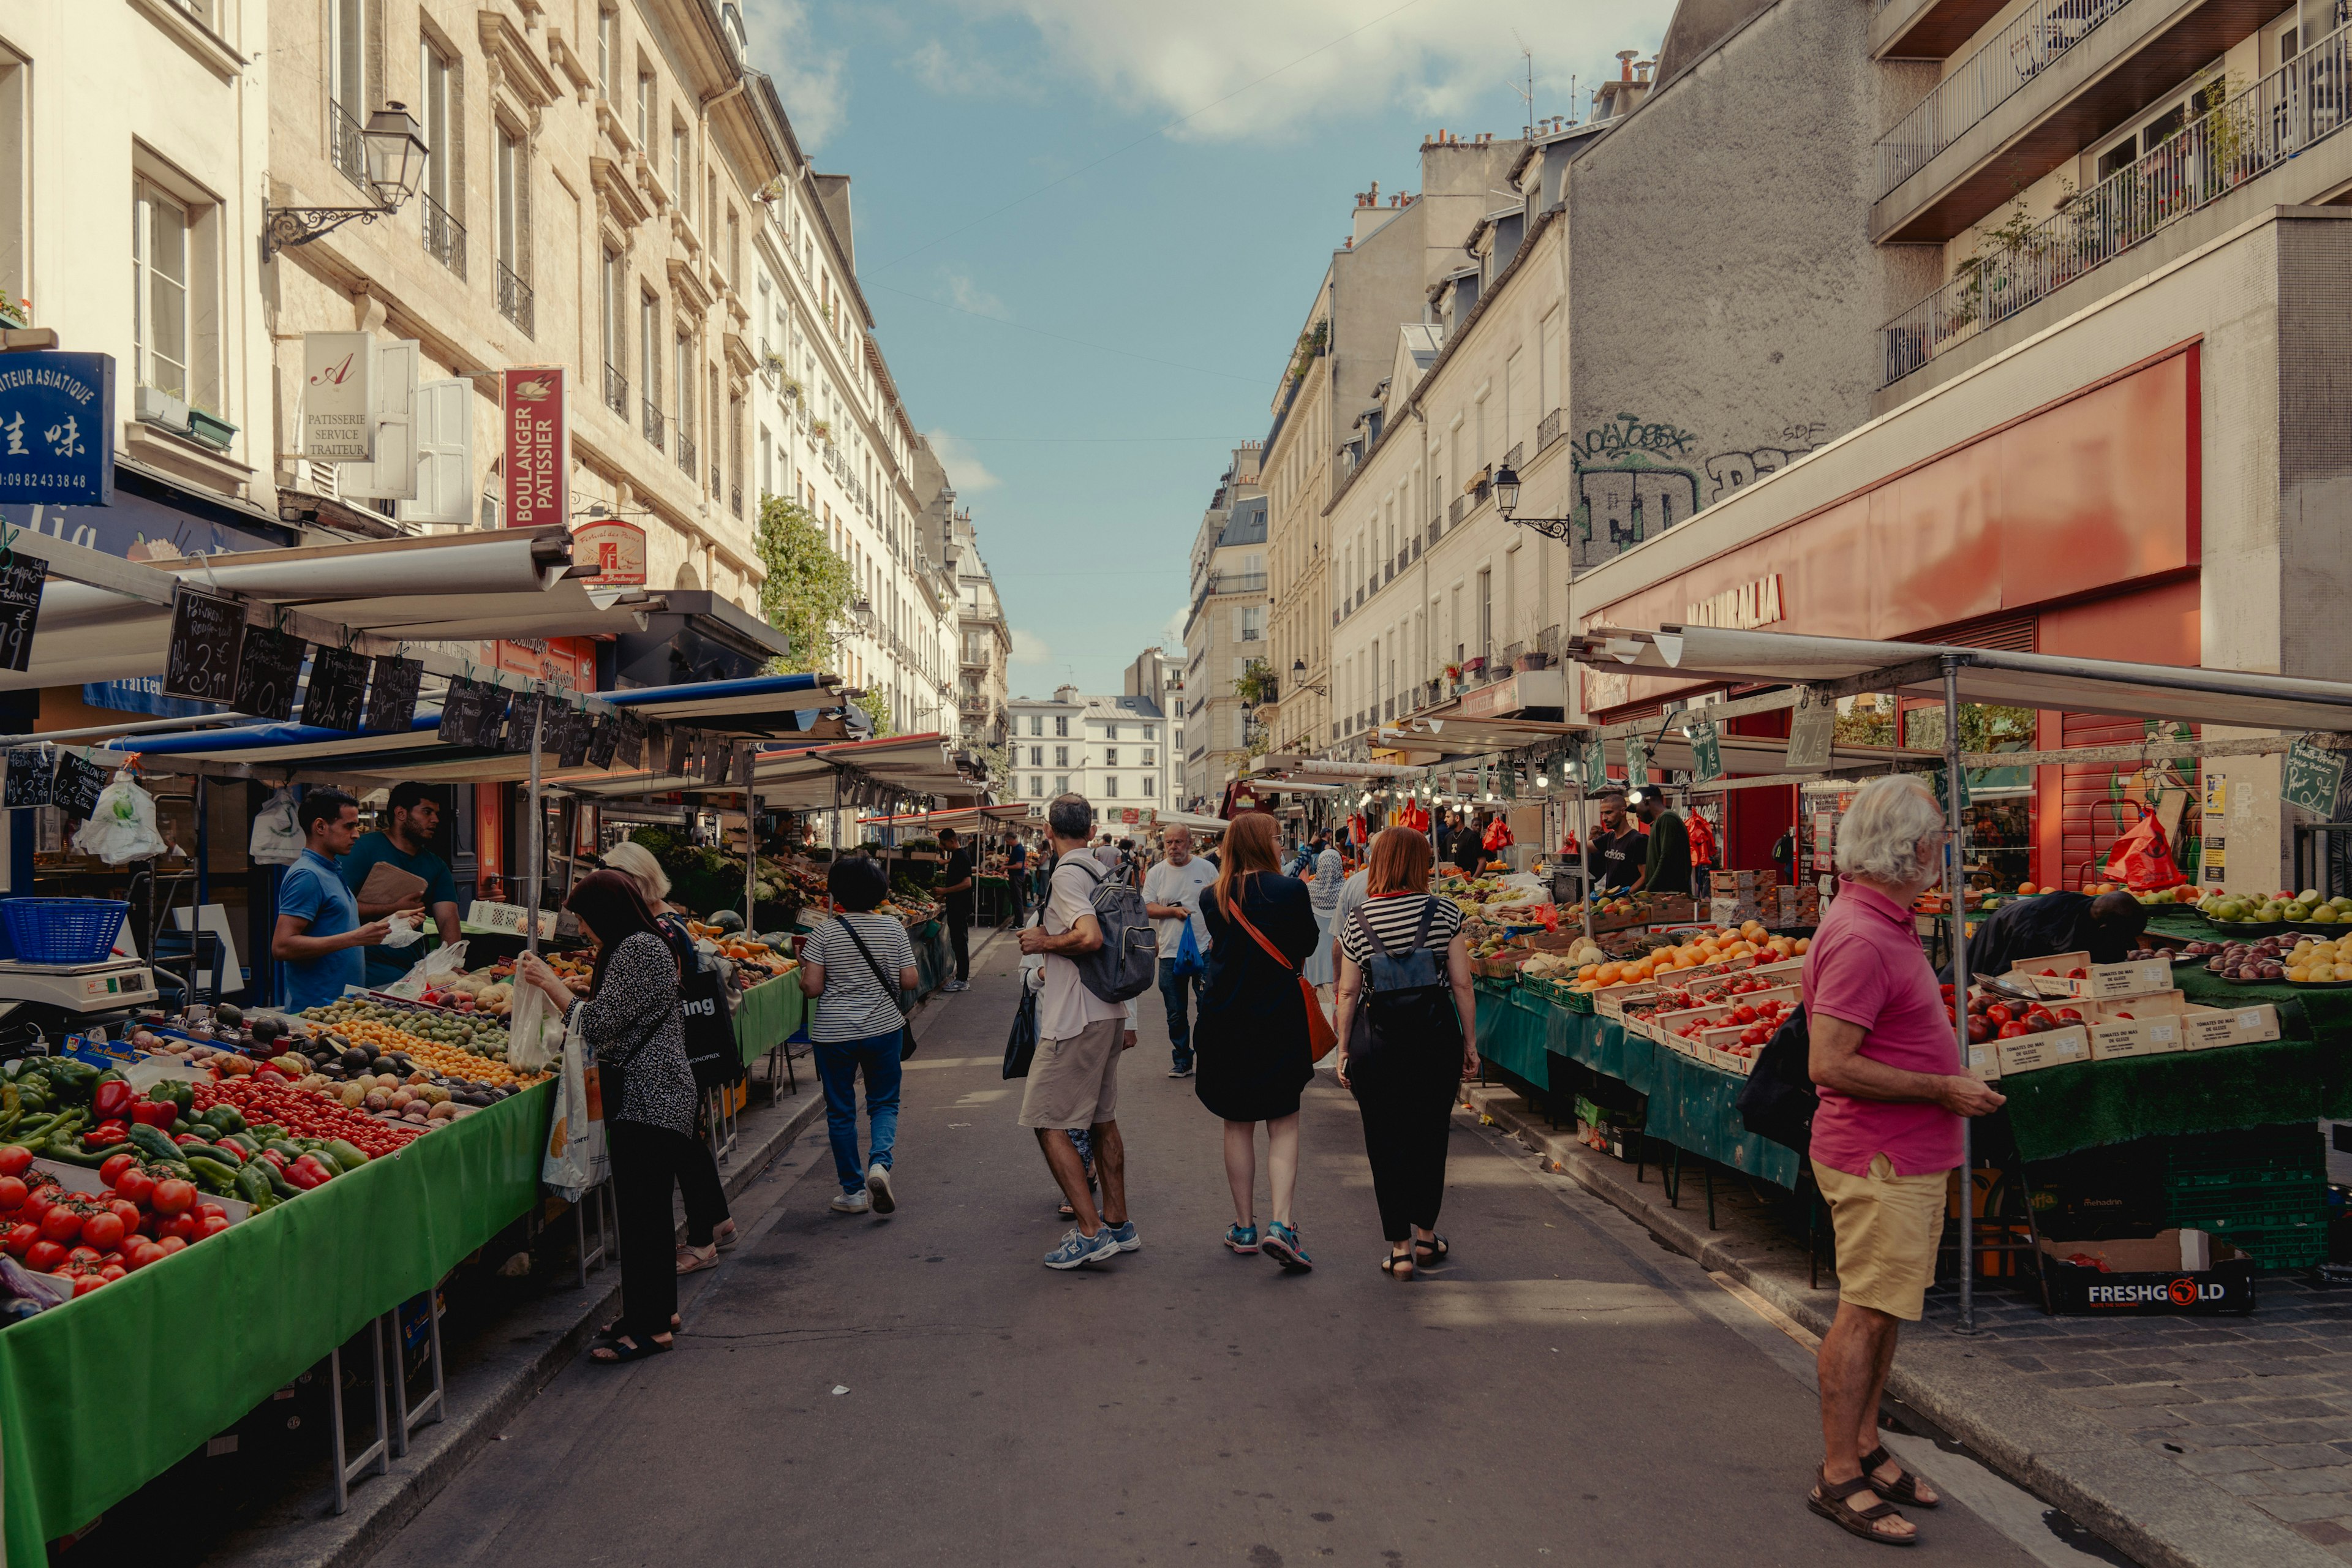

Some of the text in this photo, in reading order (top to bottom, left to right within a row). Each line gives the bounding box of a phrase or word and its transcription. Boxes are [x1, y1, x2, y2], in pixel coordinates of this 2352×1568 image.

[36, 369, 95, 405] ASIATIQUE
[308, 415, 365, 424] PATISSERIE
[315, 430, 358, 440] SERVICE
[1784, 423, 1826, 441] SDF
[310, 445, 364, 454] TRAITEUR
[516, 407, 533, 521] BOULANGER
[537, 420, 552, 508] PATISSIER
[24, 473, 37, 486] 82
[40, 474, 53, 487] 43
[57, 475, 69, 488] 38
[73, 475, 86, 488] 48
[579, 530, 606, 544] Festival
[621, 531, 639, 543] Pains
[605, 574, 640, 584] Boulanger
[1687, 573, 1782, 630] NATURALIA
[72, 758, 99, 779] MELON
[1604, 849, 1626, 861] adidas
[88, 1043, 102, 1053] The
[104, 1047, 133, 1061] Beautiful
[686, 1052, 720, 1065] MONOPRIX
[2084, 1197, 2122, 1207] mehadrin
